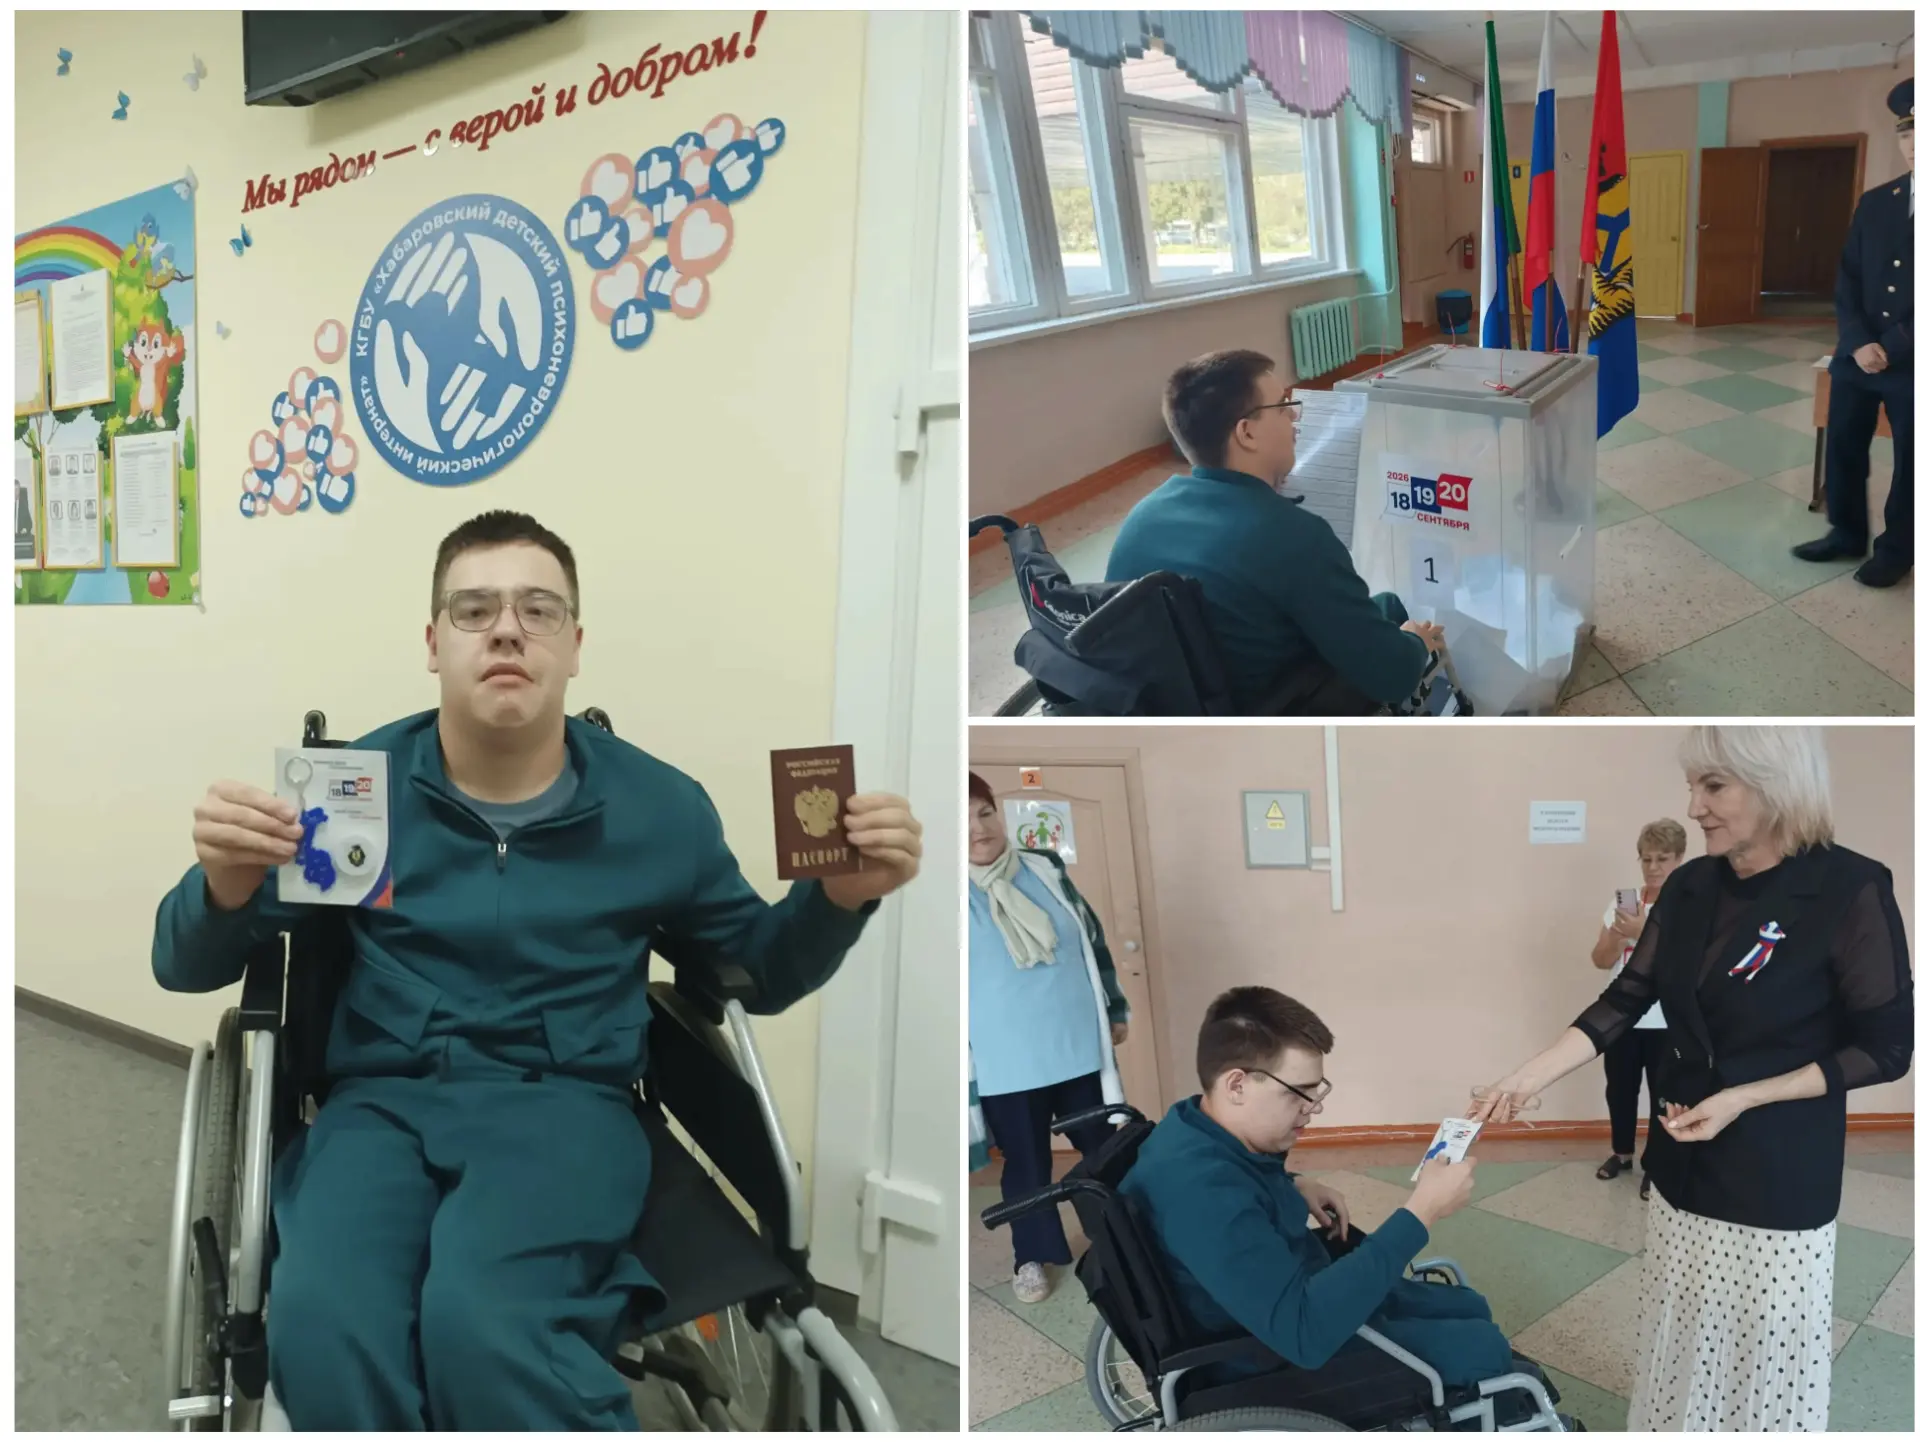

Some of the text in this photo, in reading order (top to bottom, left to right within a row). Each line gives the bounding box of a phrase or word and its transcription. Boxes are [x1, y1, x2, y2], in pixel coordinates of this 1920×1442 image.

[241, 174, 287, 213] Мы
[289, 150, 377, 208] рядом
[449, 82, 547, 152] верой
[555, 84, 578, 117] и
[587, 9, 768, 105] добром!
[373, 201, 493, 294] «Хабаровский
[355, 298, 375, 357] КГБУ
[416, 280, 568, 475] психоневрологический
[360, 375, 414, 465] интернат»
[1386, 470, 1409, 482] 2026
[1390, 481, 1466, 511] 18 19 20
[1416, 512, 1470, 531] СЕНТЯБРЯ
[1423, 556, 1439, 584] 1
[1027, 773, 1036, 784] 2
[791, 847, 848, 867] ПАСПОРТ
